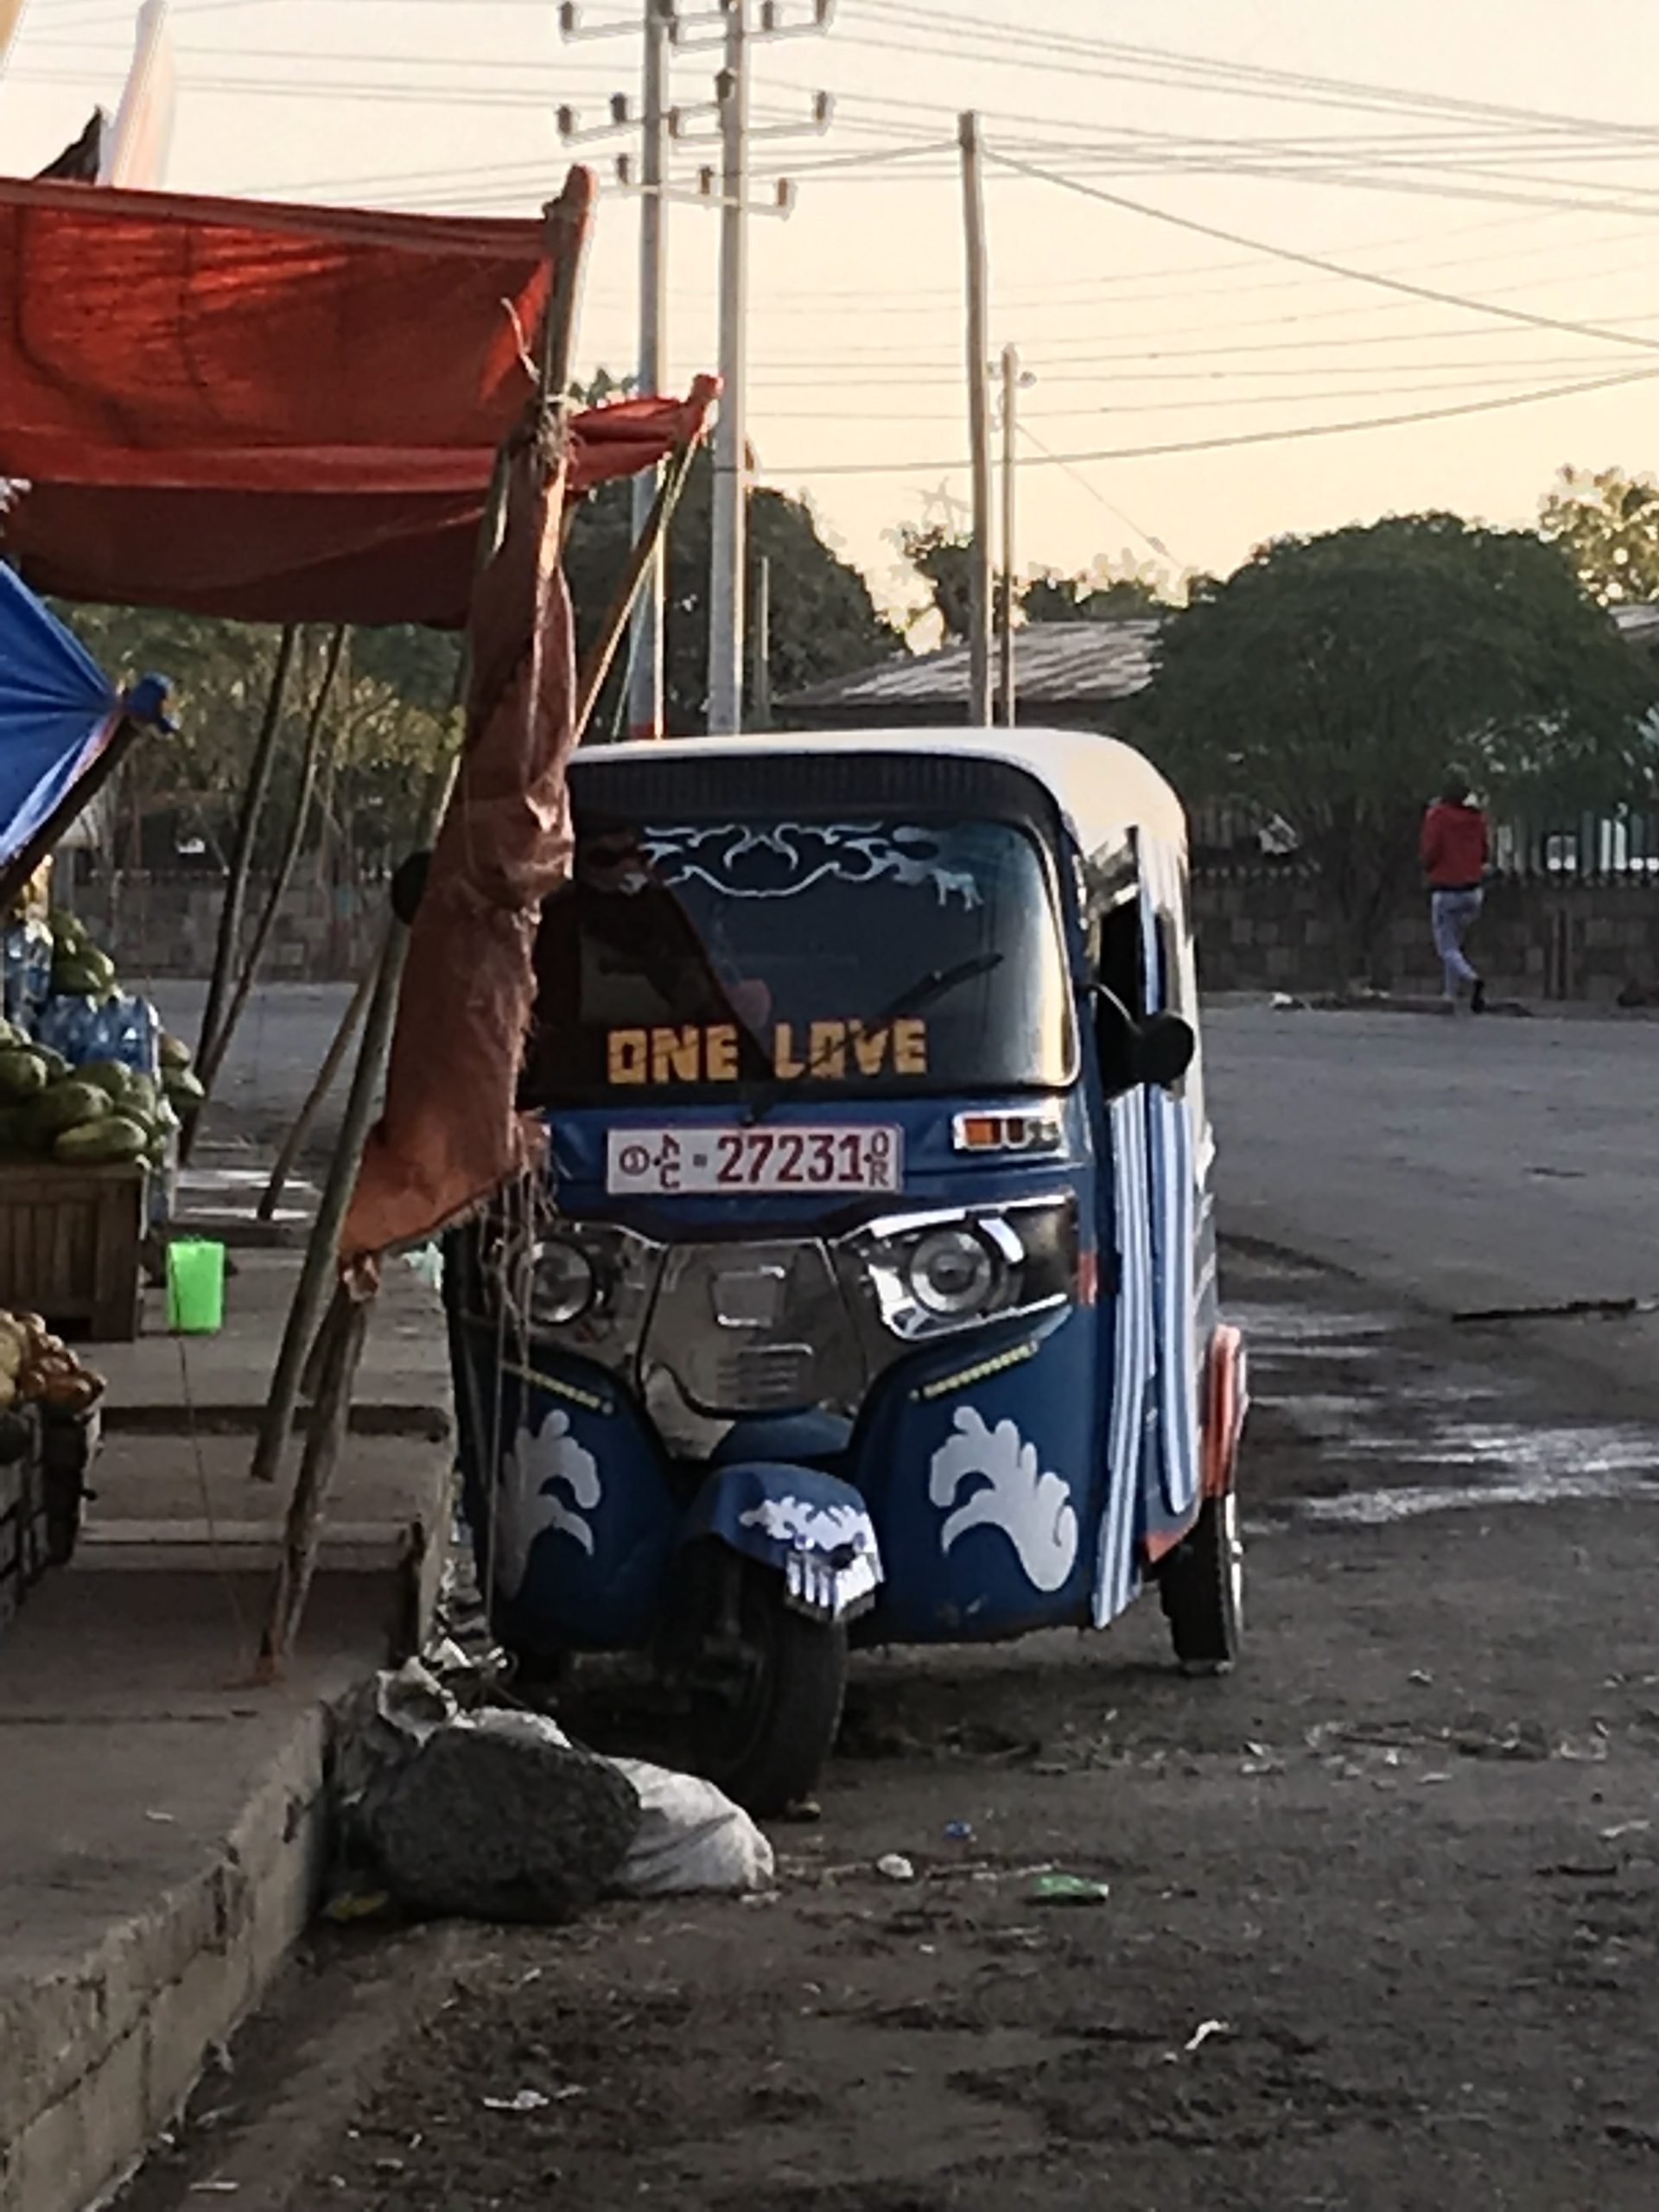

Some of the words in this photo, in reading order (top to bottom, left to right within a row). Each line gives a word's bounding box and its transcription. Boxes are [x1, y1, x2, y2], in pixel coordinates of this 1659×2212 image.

[608, 1024, 739, 1084] ONE
[774, 1018, 926, 1079] LOVE
[716, 1134, 865, 1184] 27231
